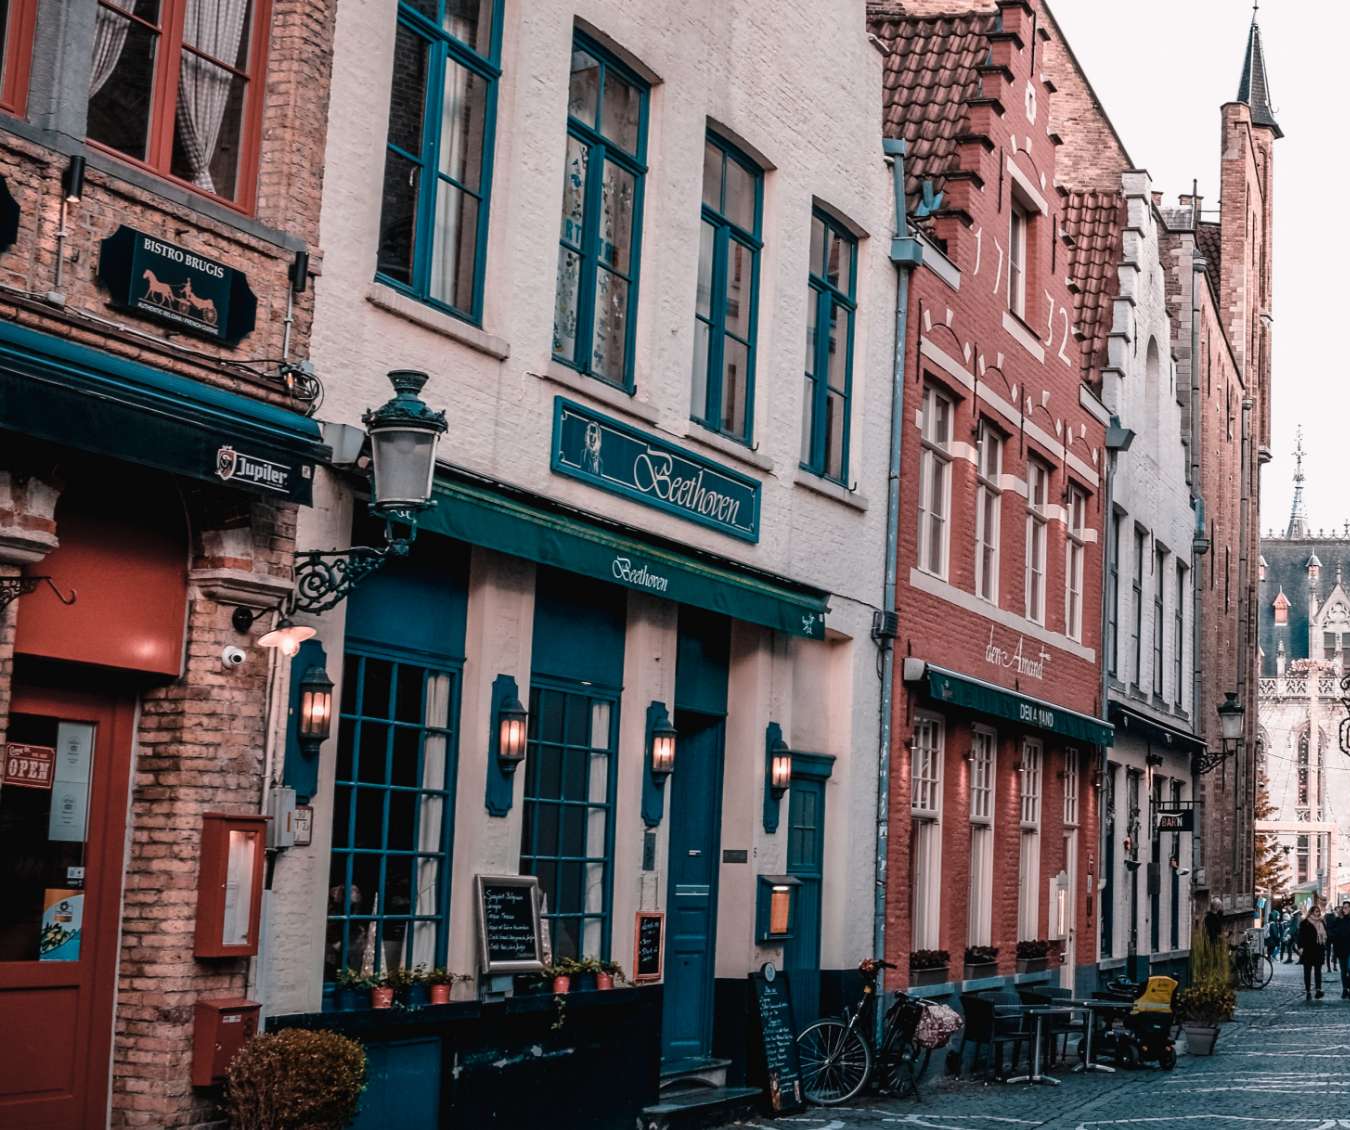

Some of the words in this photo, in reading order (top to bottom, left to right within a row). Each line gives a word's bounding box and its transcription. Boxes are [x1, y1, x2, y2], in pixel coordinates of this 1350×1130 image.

[143, 238, 184, 263] BISTRO
[185, 254, 225, 279] BRUGIS
[236, 457, 288, 485] Jupiler
[634, 443, 741, 525] Beethoven
[612, 554, 669, 592] Beethoven
[985, 624, 1001, 665] den
[9, 759, 49, 779] OPEN
